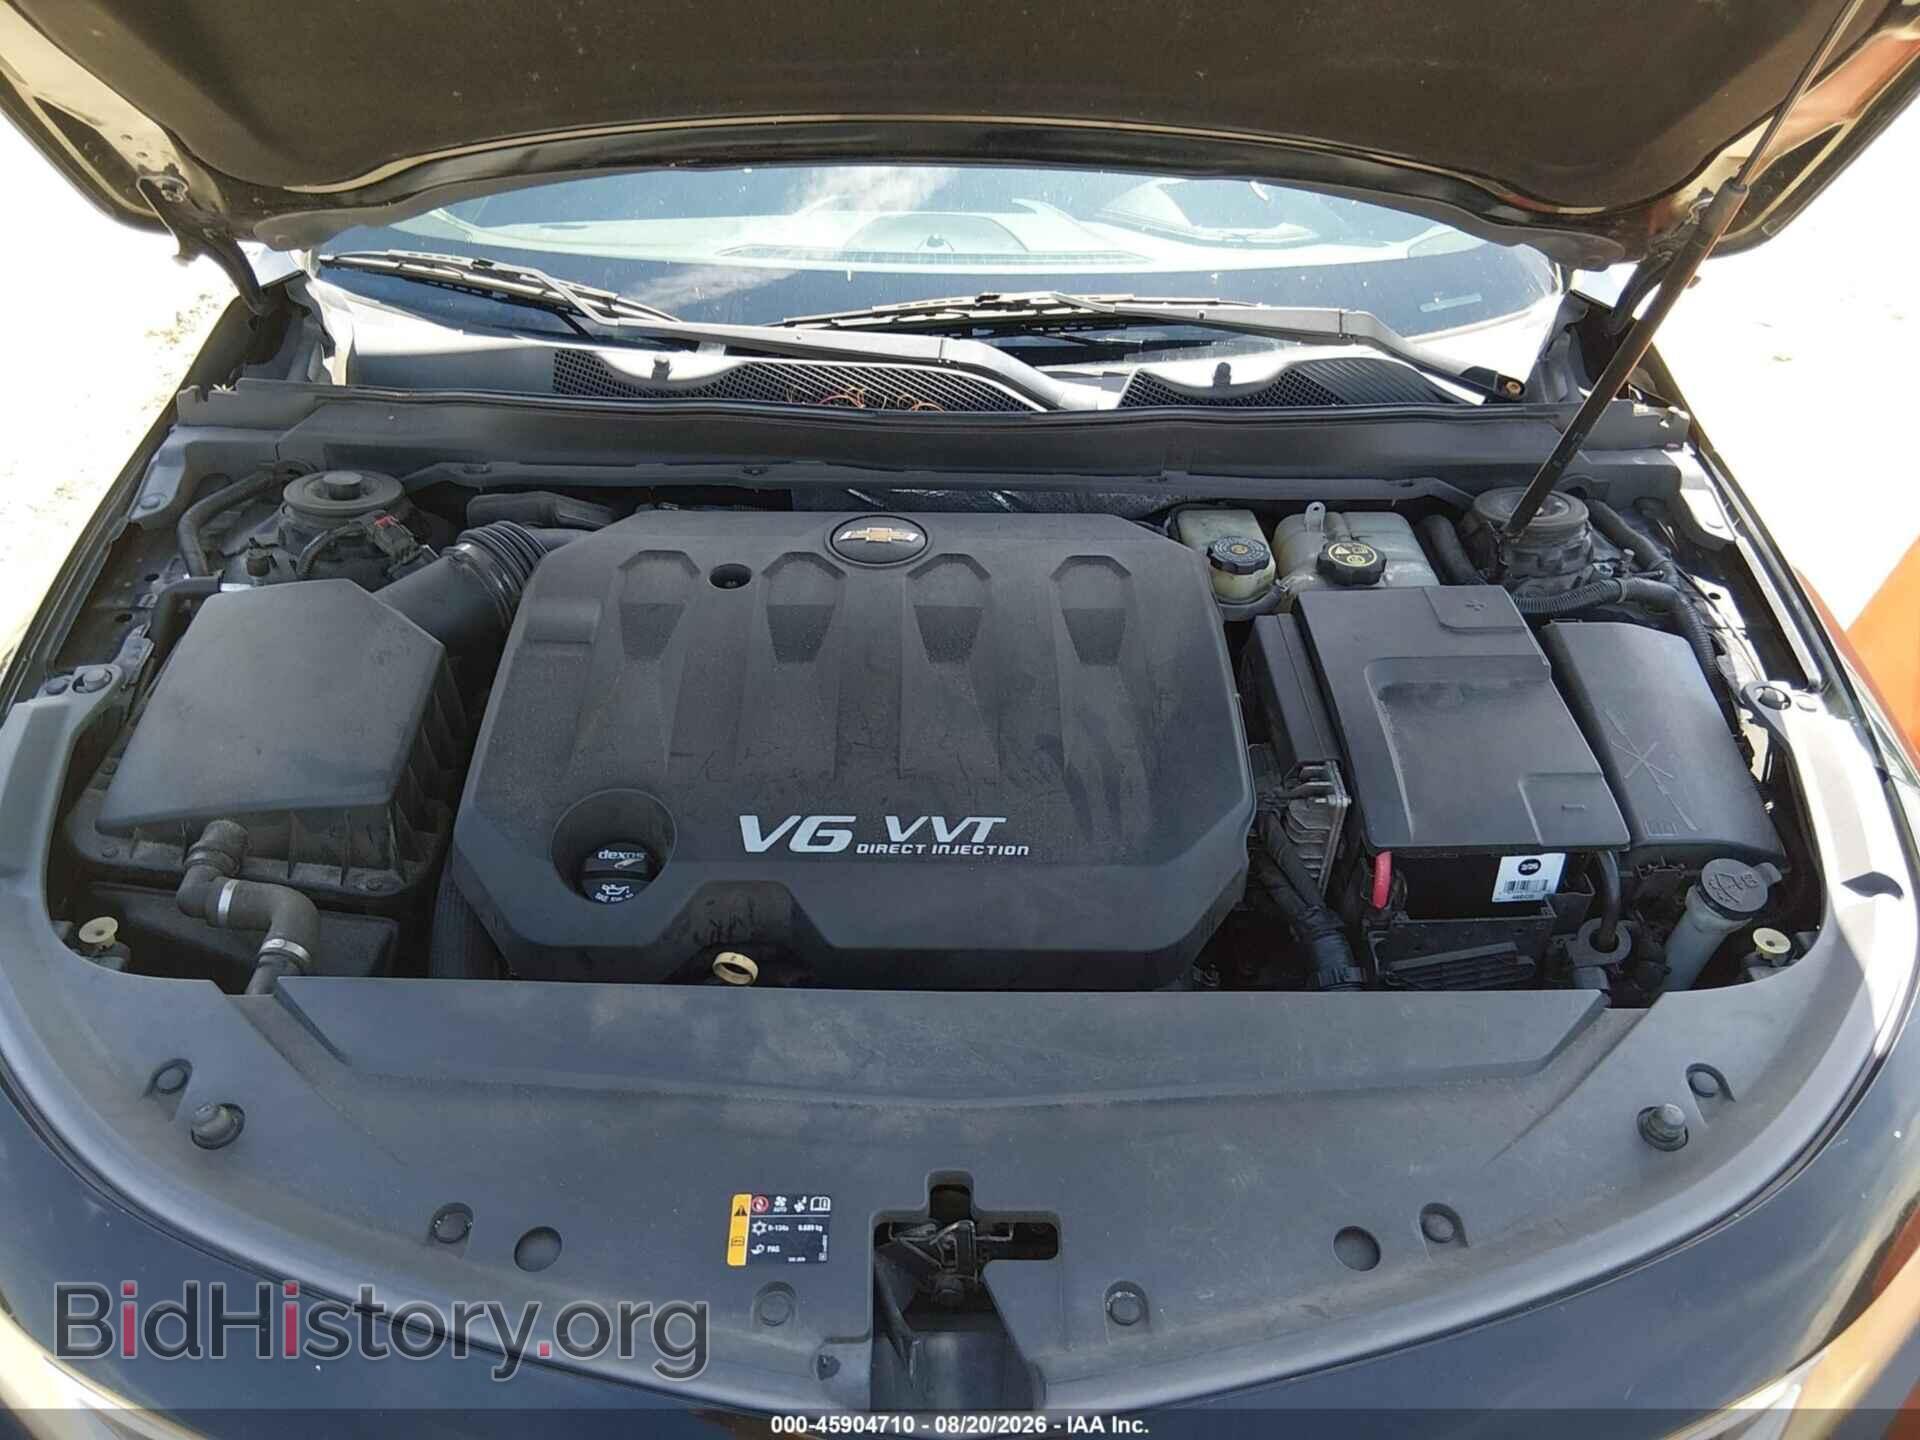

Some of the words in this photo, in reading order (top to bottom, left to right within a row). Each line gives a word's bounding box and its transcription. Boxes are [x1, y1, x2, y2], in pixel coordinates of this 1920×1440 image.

[738, 814, 856, 853] V6
[884, 815, 1007, 843] VVT
[597, 848, 646, 860] dexos
[856, 843, 926, 855] DIRECT
